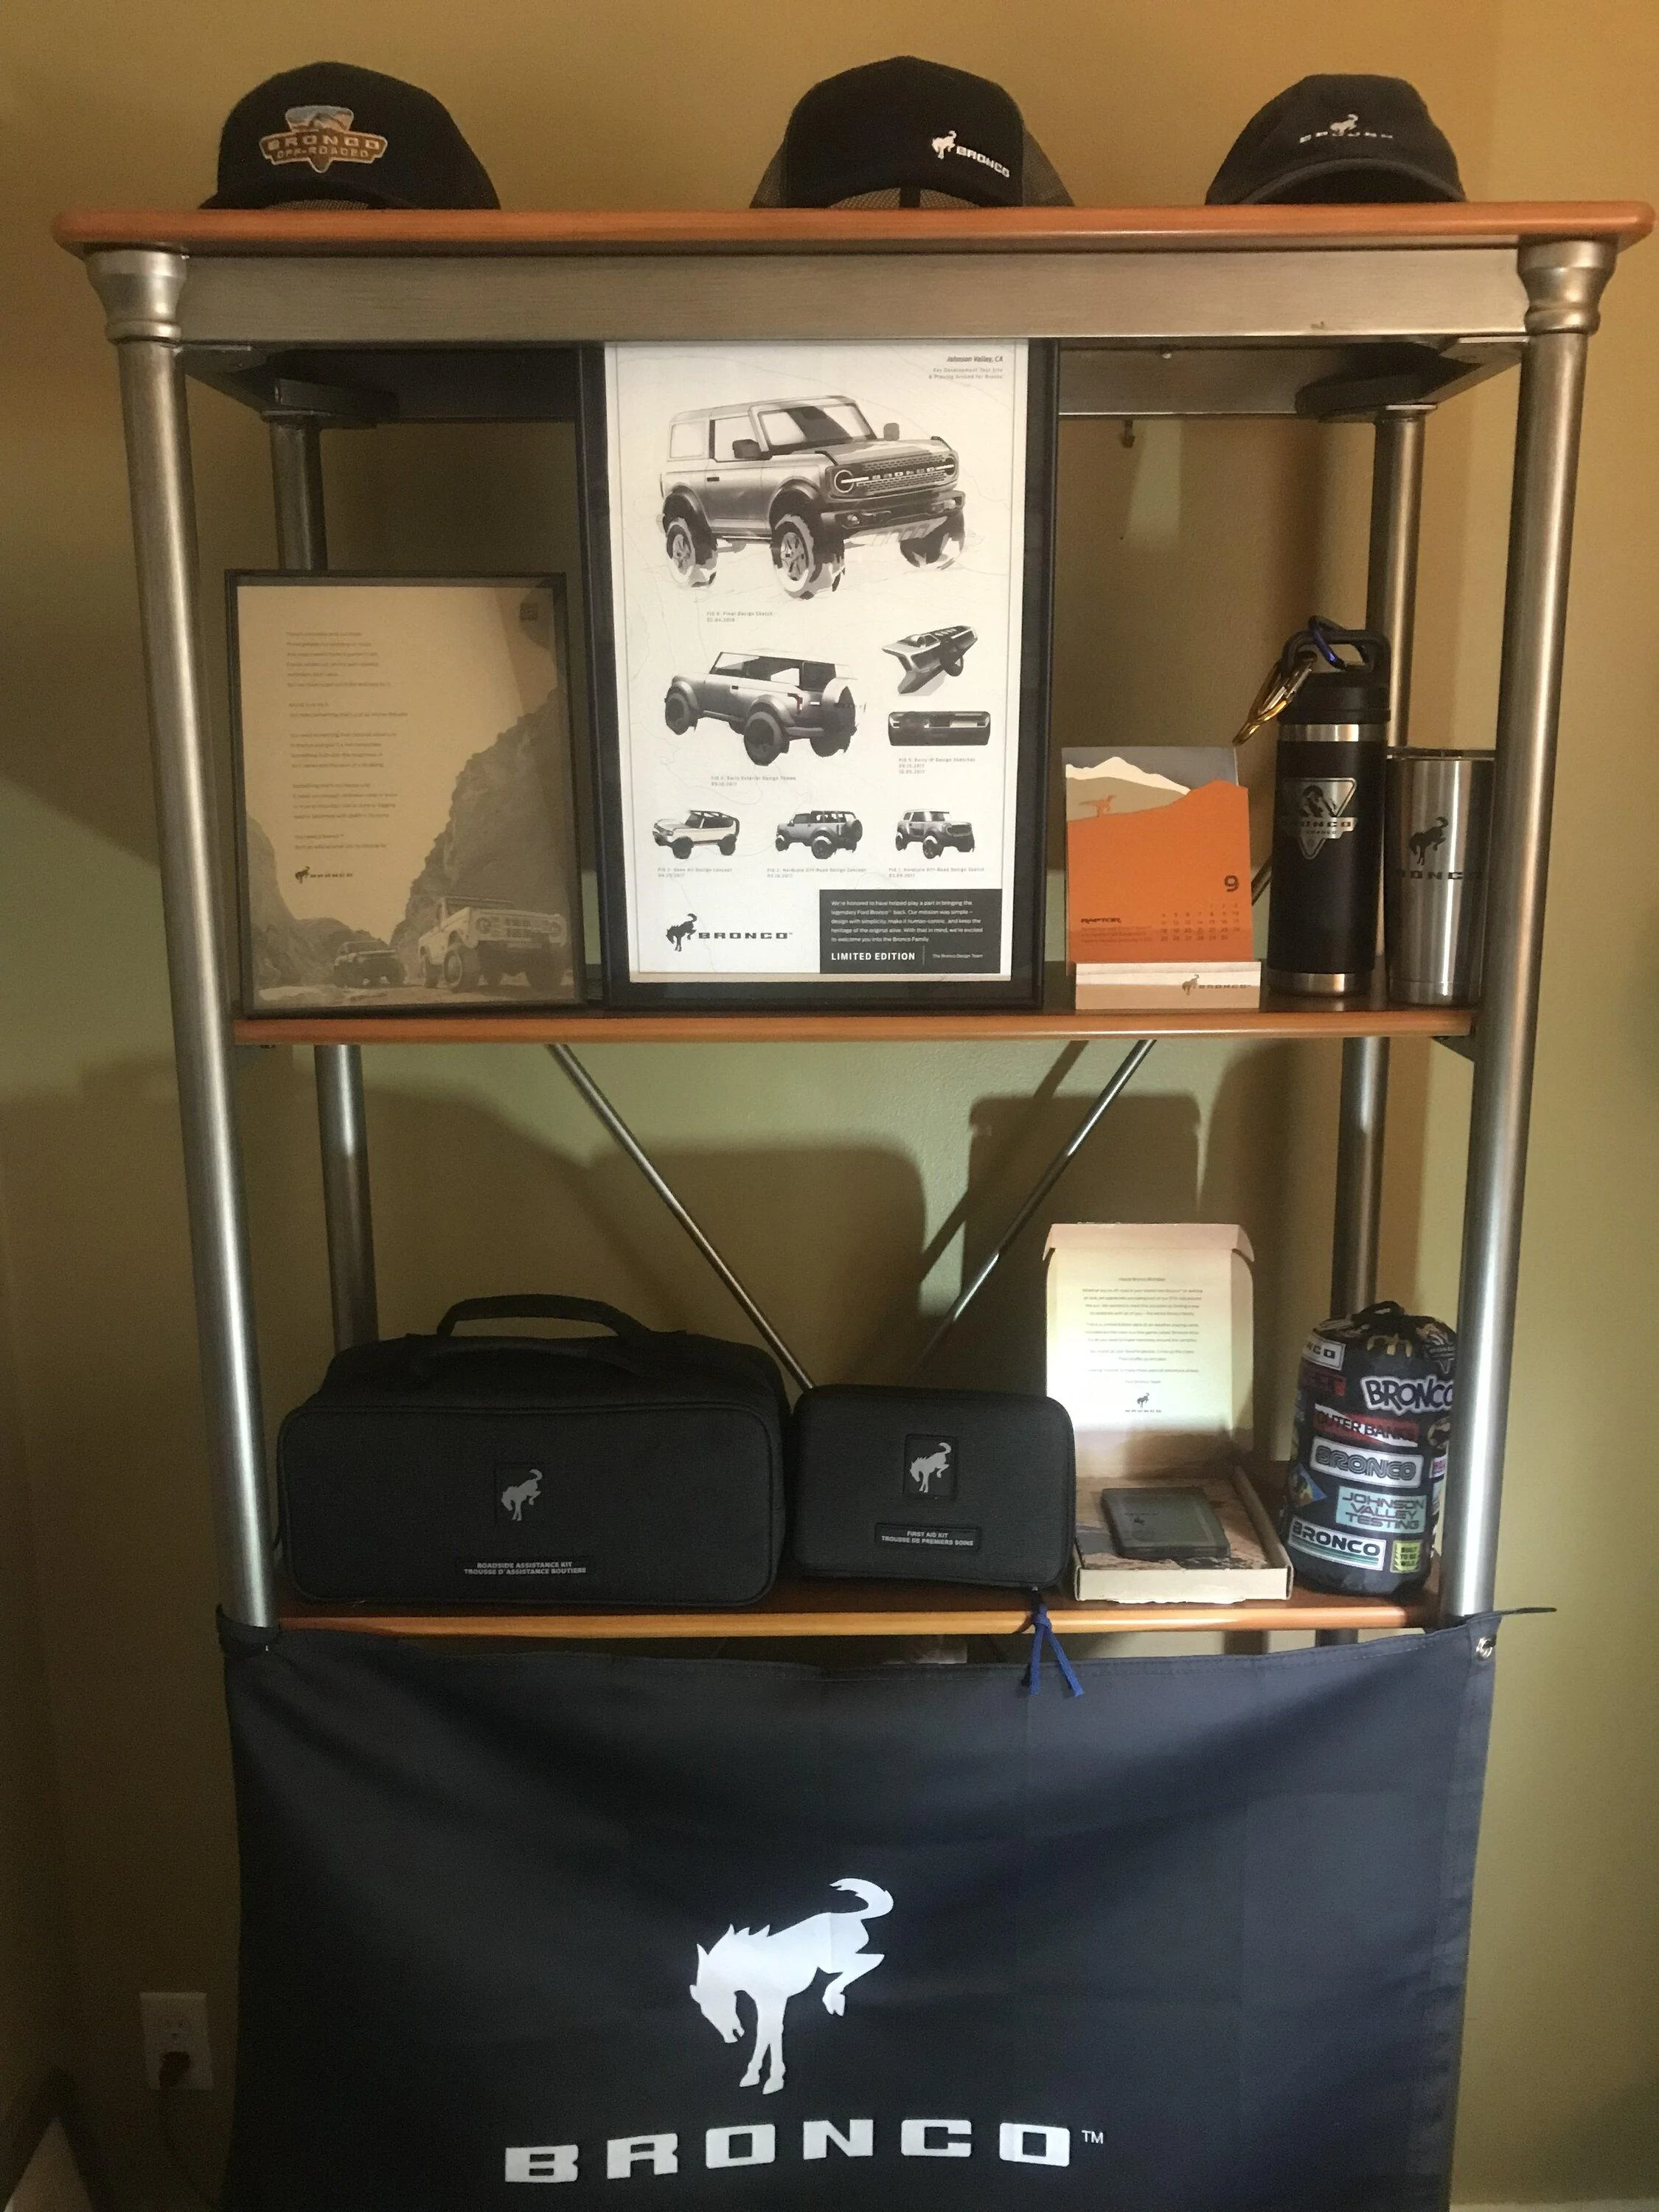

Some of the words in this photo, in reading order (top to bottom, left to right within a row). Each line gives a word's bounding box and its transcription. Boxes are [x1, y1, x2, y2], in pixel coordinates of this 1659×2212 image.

[267, 135, 380, 150] BRONCO
[956, 145, 1010, 178] BRONCO
[872, 467, 936, 480] BRONCO
[1224, 875, 1239, 892] 9
[831, 952, 872, 961] LIMITED
[874, 952, 916, 961] EDITION
[1315, 1444, 1417, 1481] BRONCO
[1342, 1492, 1425, 1509] JOHNSON
[1350, 1503, 1418, 1520] VALLEY
[1345, 1512, 1419, 1530] TESTING
[1292, 1519, 1381, 1557] BRONCO
[504, 2118, 1071, 2184] BRONCO
